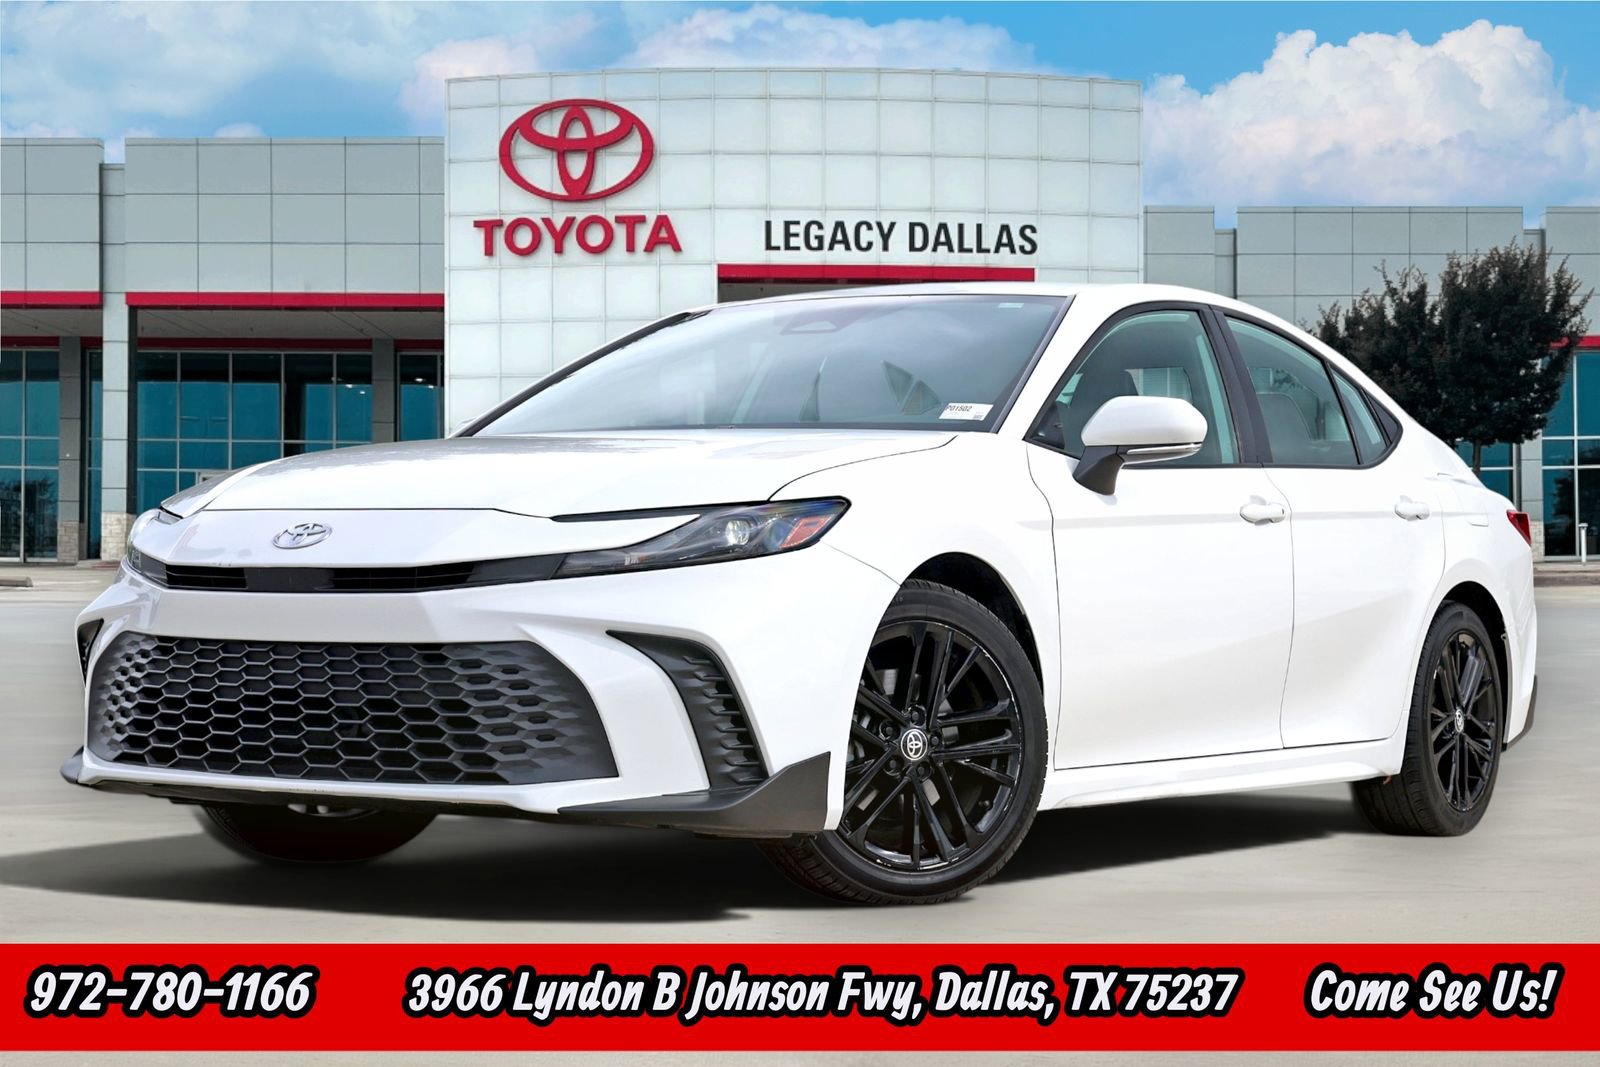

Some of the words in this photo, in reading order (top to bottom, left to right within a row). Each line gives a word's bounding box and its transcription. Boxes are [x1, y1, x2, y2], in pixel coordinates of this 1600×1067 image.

[473, 214, 682, 256] TOYOTA
[764, 219, 897, 252] LEGACY
[907, 221, 1038, 255] DALLAS
